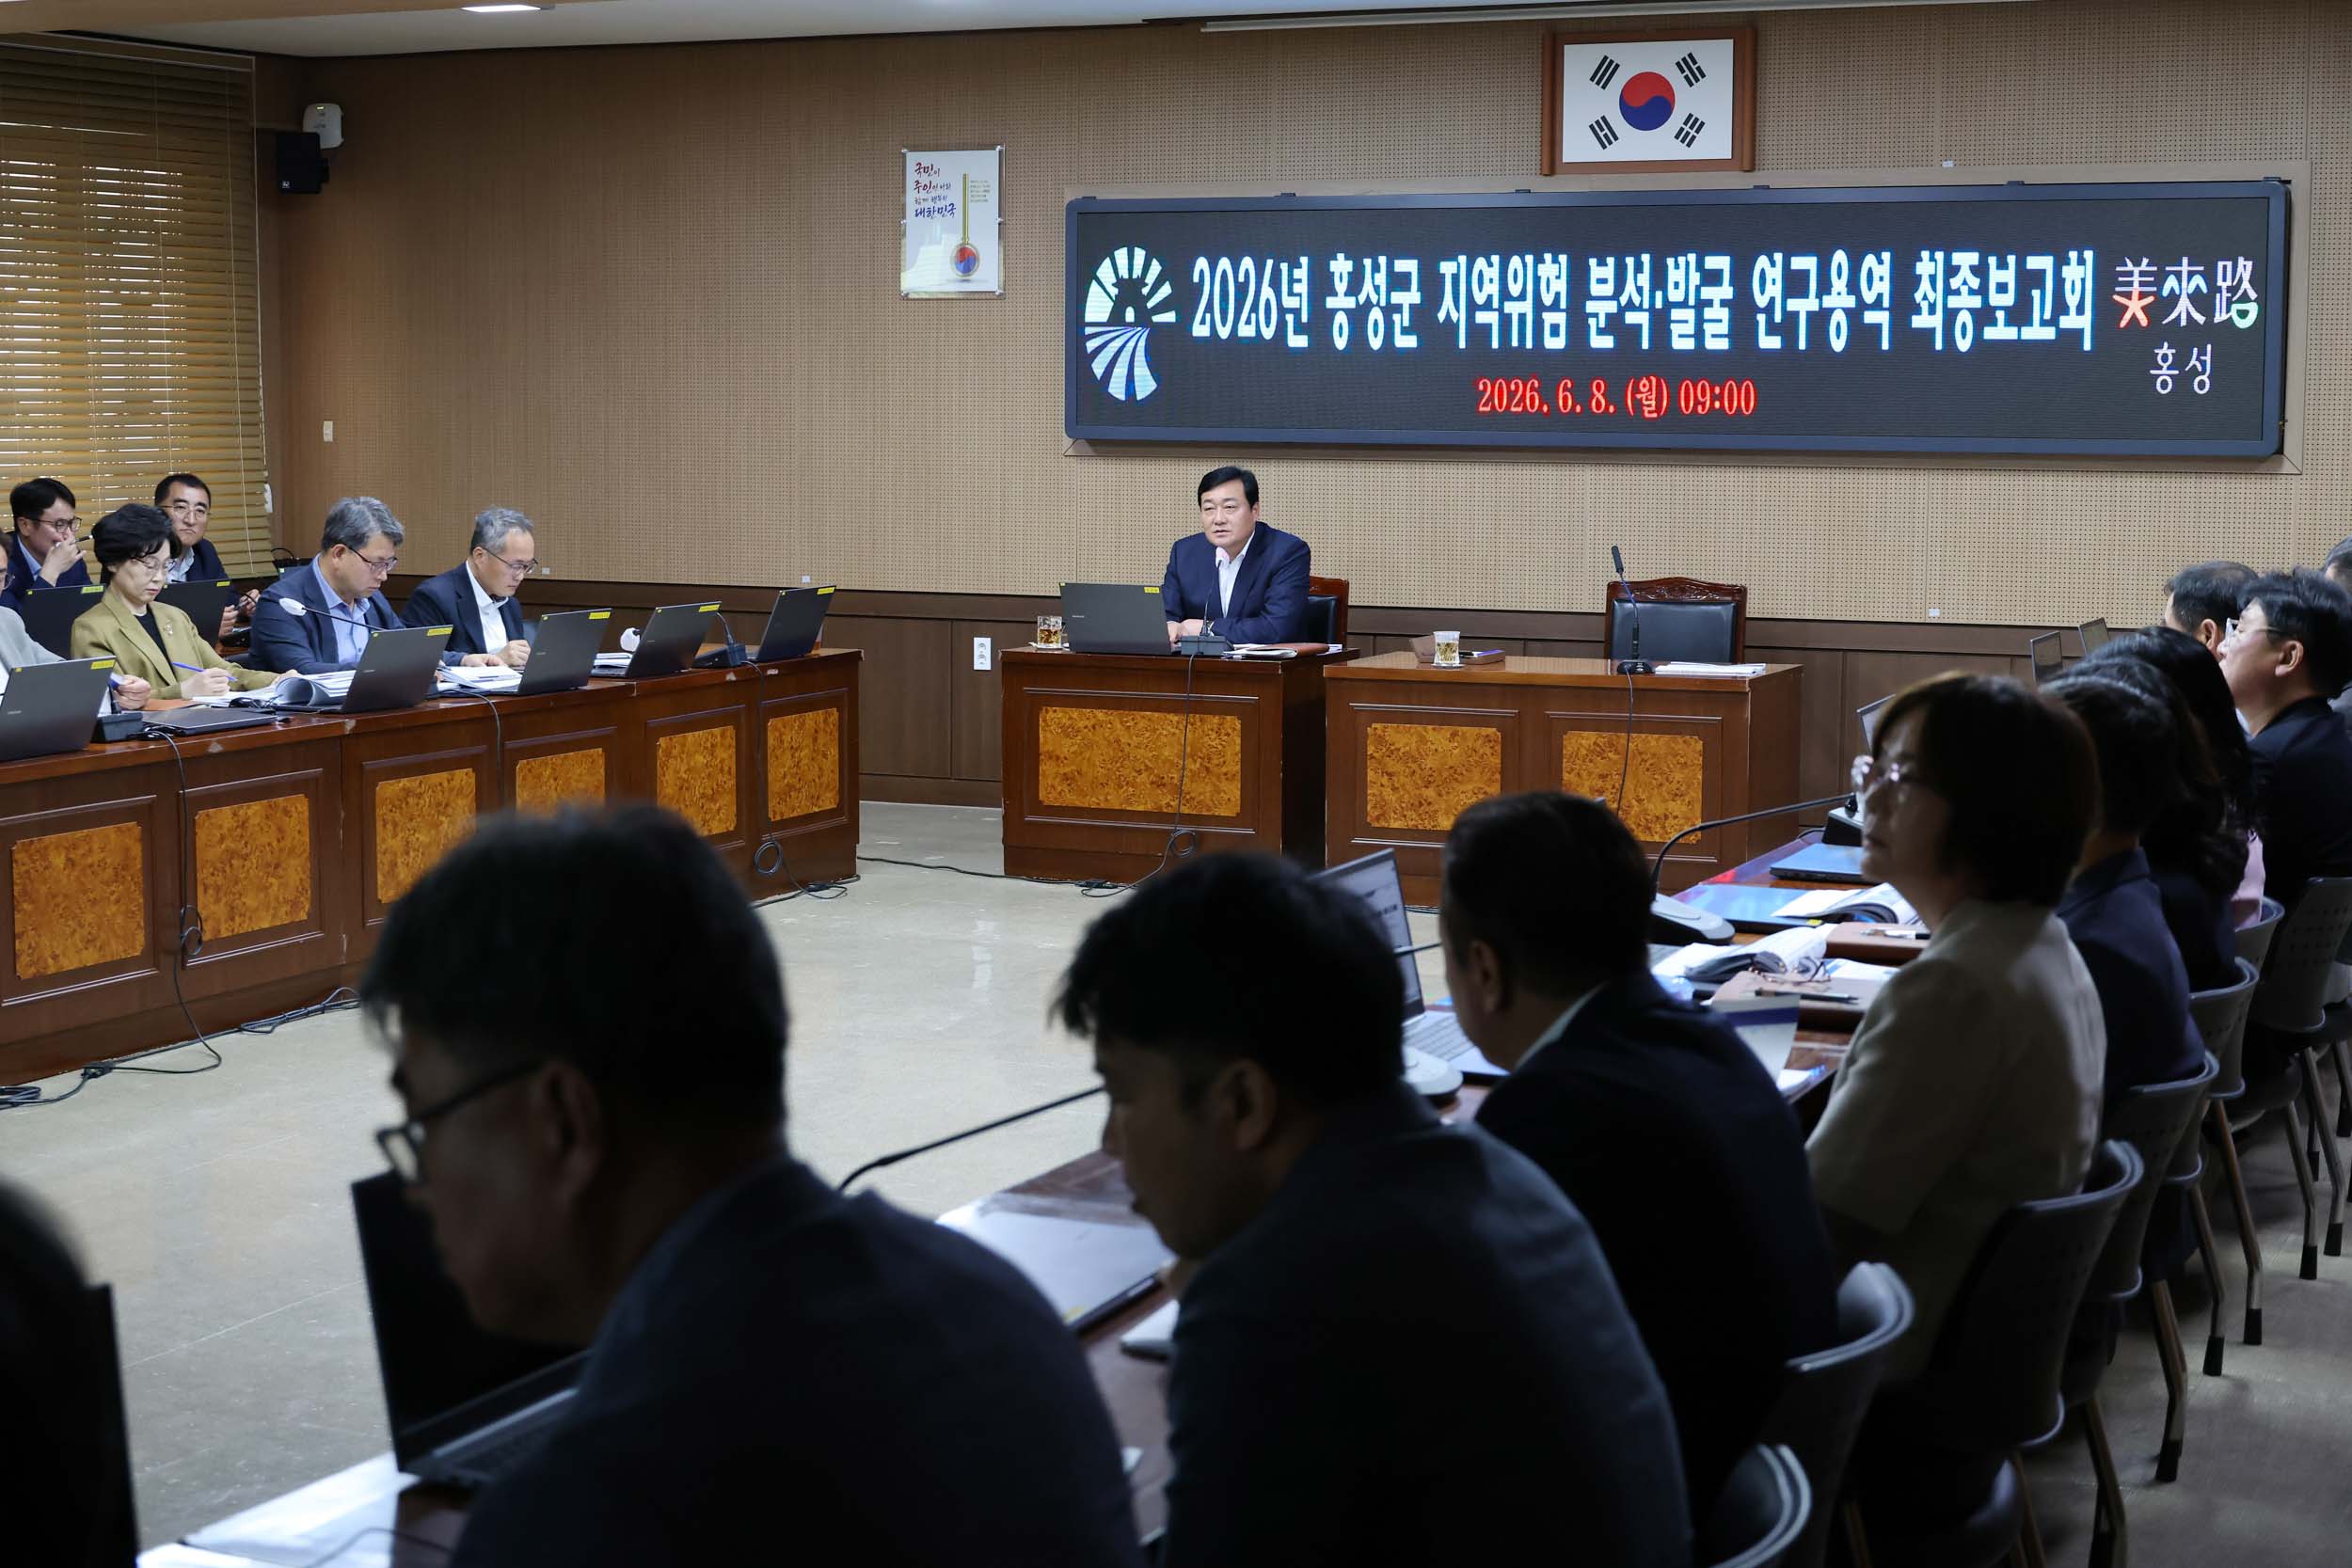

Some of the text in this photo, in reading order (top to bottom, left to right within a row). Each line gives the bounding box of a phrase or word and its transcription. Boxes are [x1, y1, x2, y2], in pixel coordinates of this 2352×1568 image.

[914, 162, 940, 178] 국민이
[914, 202, 956, 219] 대한민국
[1192, 256, 1311, 348] 2026년
[1326, 253, 1421, 352] 홍성군
[1438, 253, 1569, 349] 지역위험
[1752, 249, 1893, 352] 연구용역
[1912, 250, 2094, 352] 최종보고회
[2113, 257, 2258, 328] 美來路
[2150, 342, 2211, 394] 홍성
[1479, 376, 1756, 418] 2026. 6. 8. (월) 09:00
